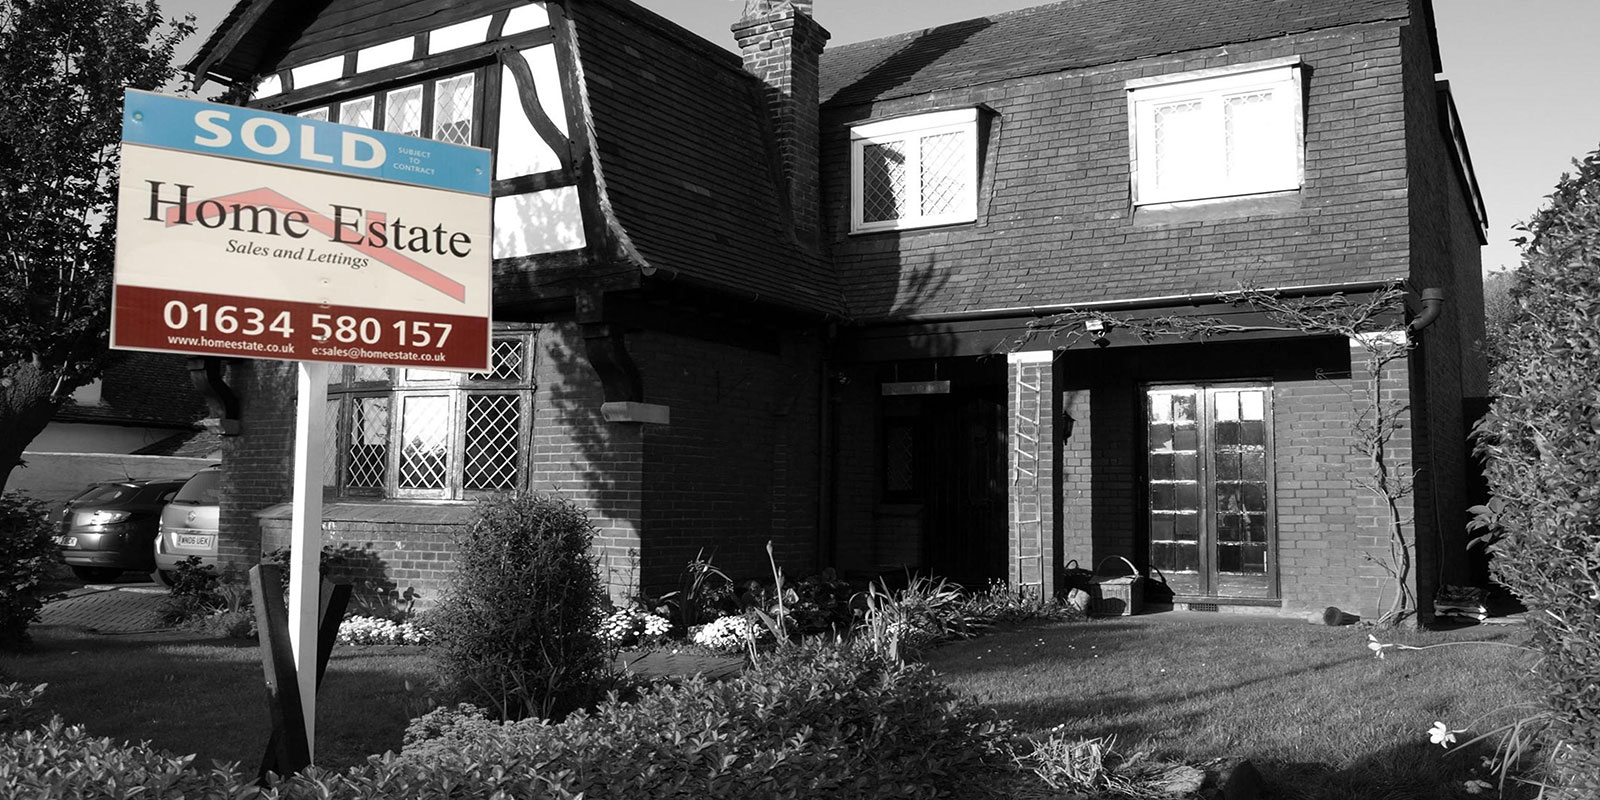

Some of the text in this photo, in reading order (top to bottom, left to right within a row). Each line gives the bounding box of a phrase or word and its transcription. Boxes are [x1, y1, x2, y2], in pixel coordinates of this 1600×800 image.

[194, 109, 387, 169] SOLD
[398, 146, 431, 159] SUBJECT
[393, 163, 435, 176] CONTRACT
[409, 157, 421, 165] TO
[143, 179, 472, 258] Home Estate
[226, 239, 369, 270] Sales and Lettings
[163, 300, 452, 348] 01634 580 157
[167, 335, 446, 362] www.homeestate.co.uk e:sales@homeestate.co.uk
